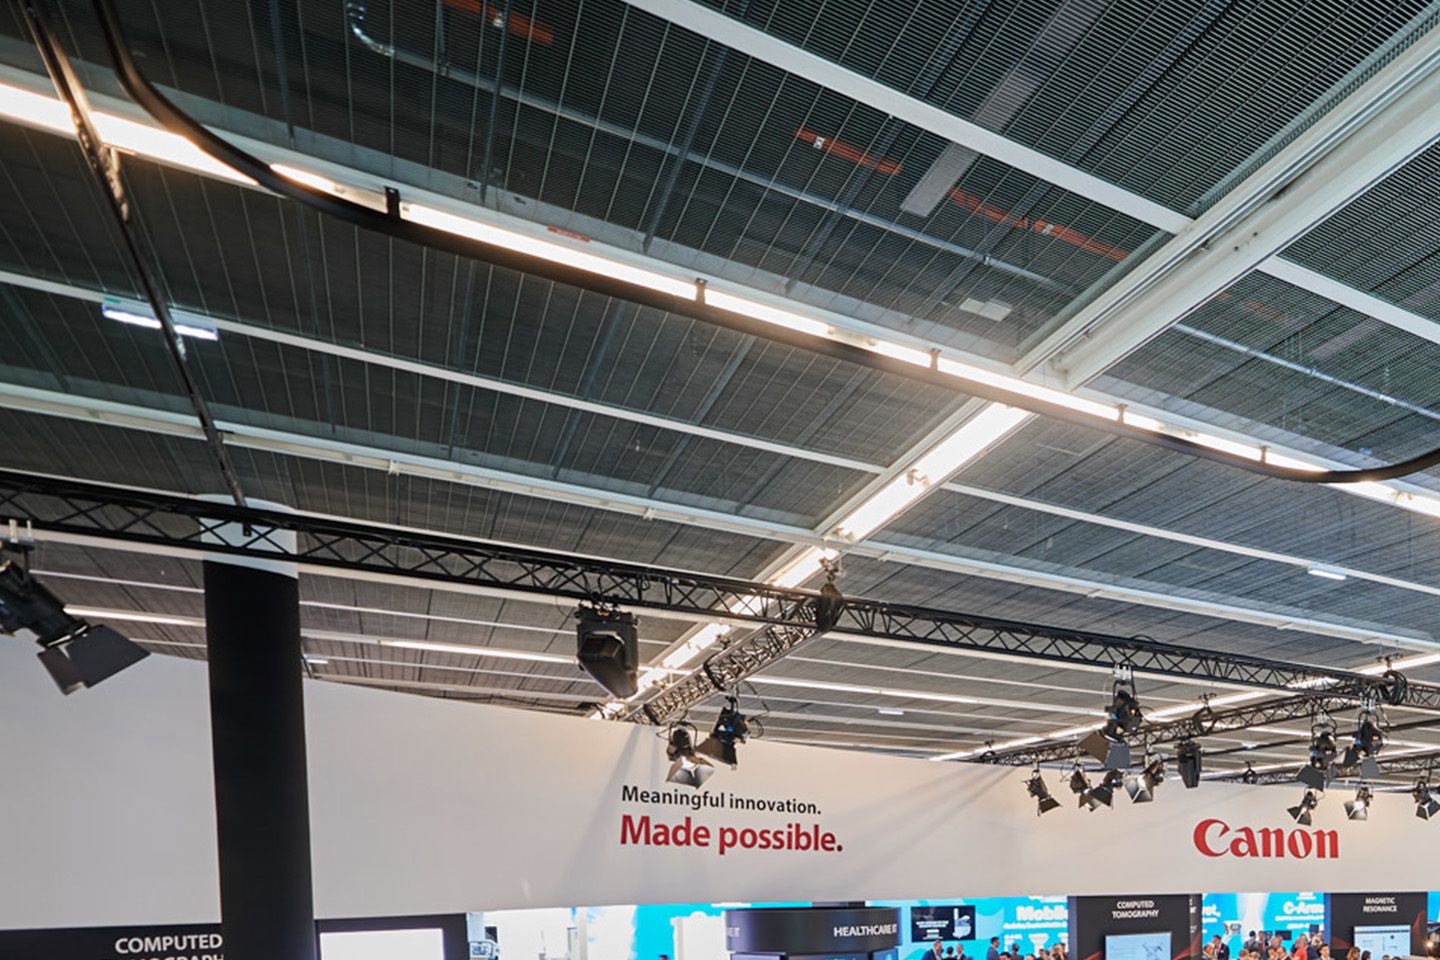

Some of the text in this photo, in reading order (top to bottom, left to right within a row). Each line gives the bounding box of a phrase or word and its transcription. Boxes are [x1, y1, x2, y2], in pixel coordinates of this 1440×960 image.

[621, 785, 822, 815] Meaningful innovation.
[620, 814, 843, 856] Made possible.
[1193, 818, 1339, 859] Canon
[1116, 900, 1155, 910] COMPUTED
[1365, 897, 1396, 905] MAGNETIC
[1112, 909, 1160, 919] TOMOGRAPHY
[1363, 905, 1398, 913] RESONANCE
[833, 925, 892, 937] HEALTHCARE
[115, 934, 223, 954] COMPUTED
